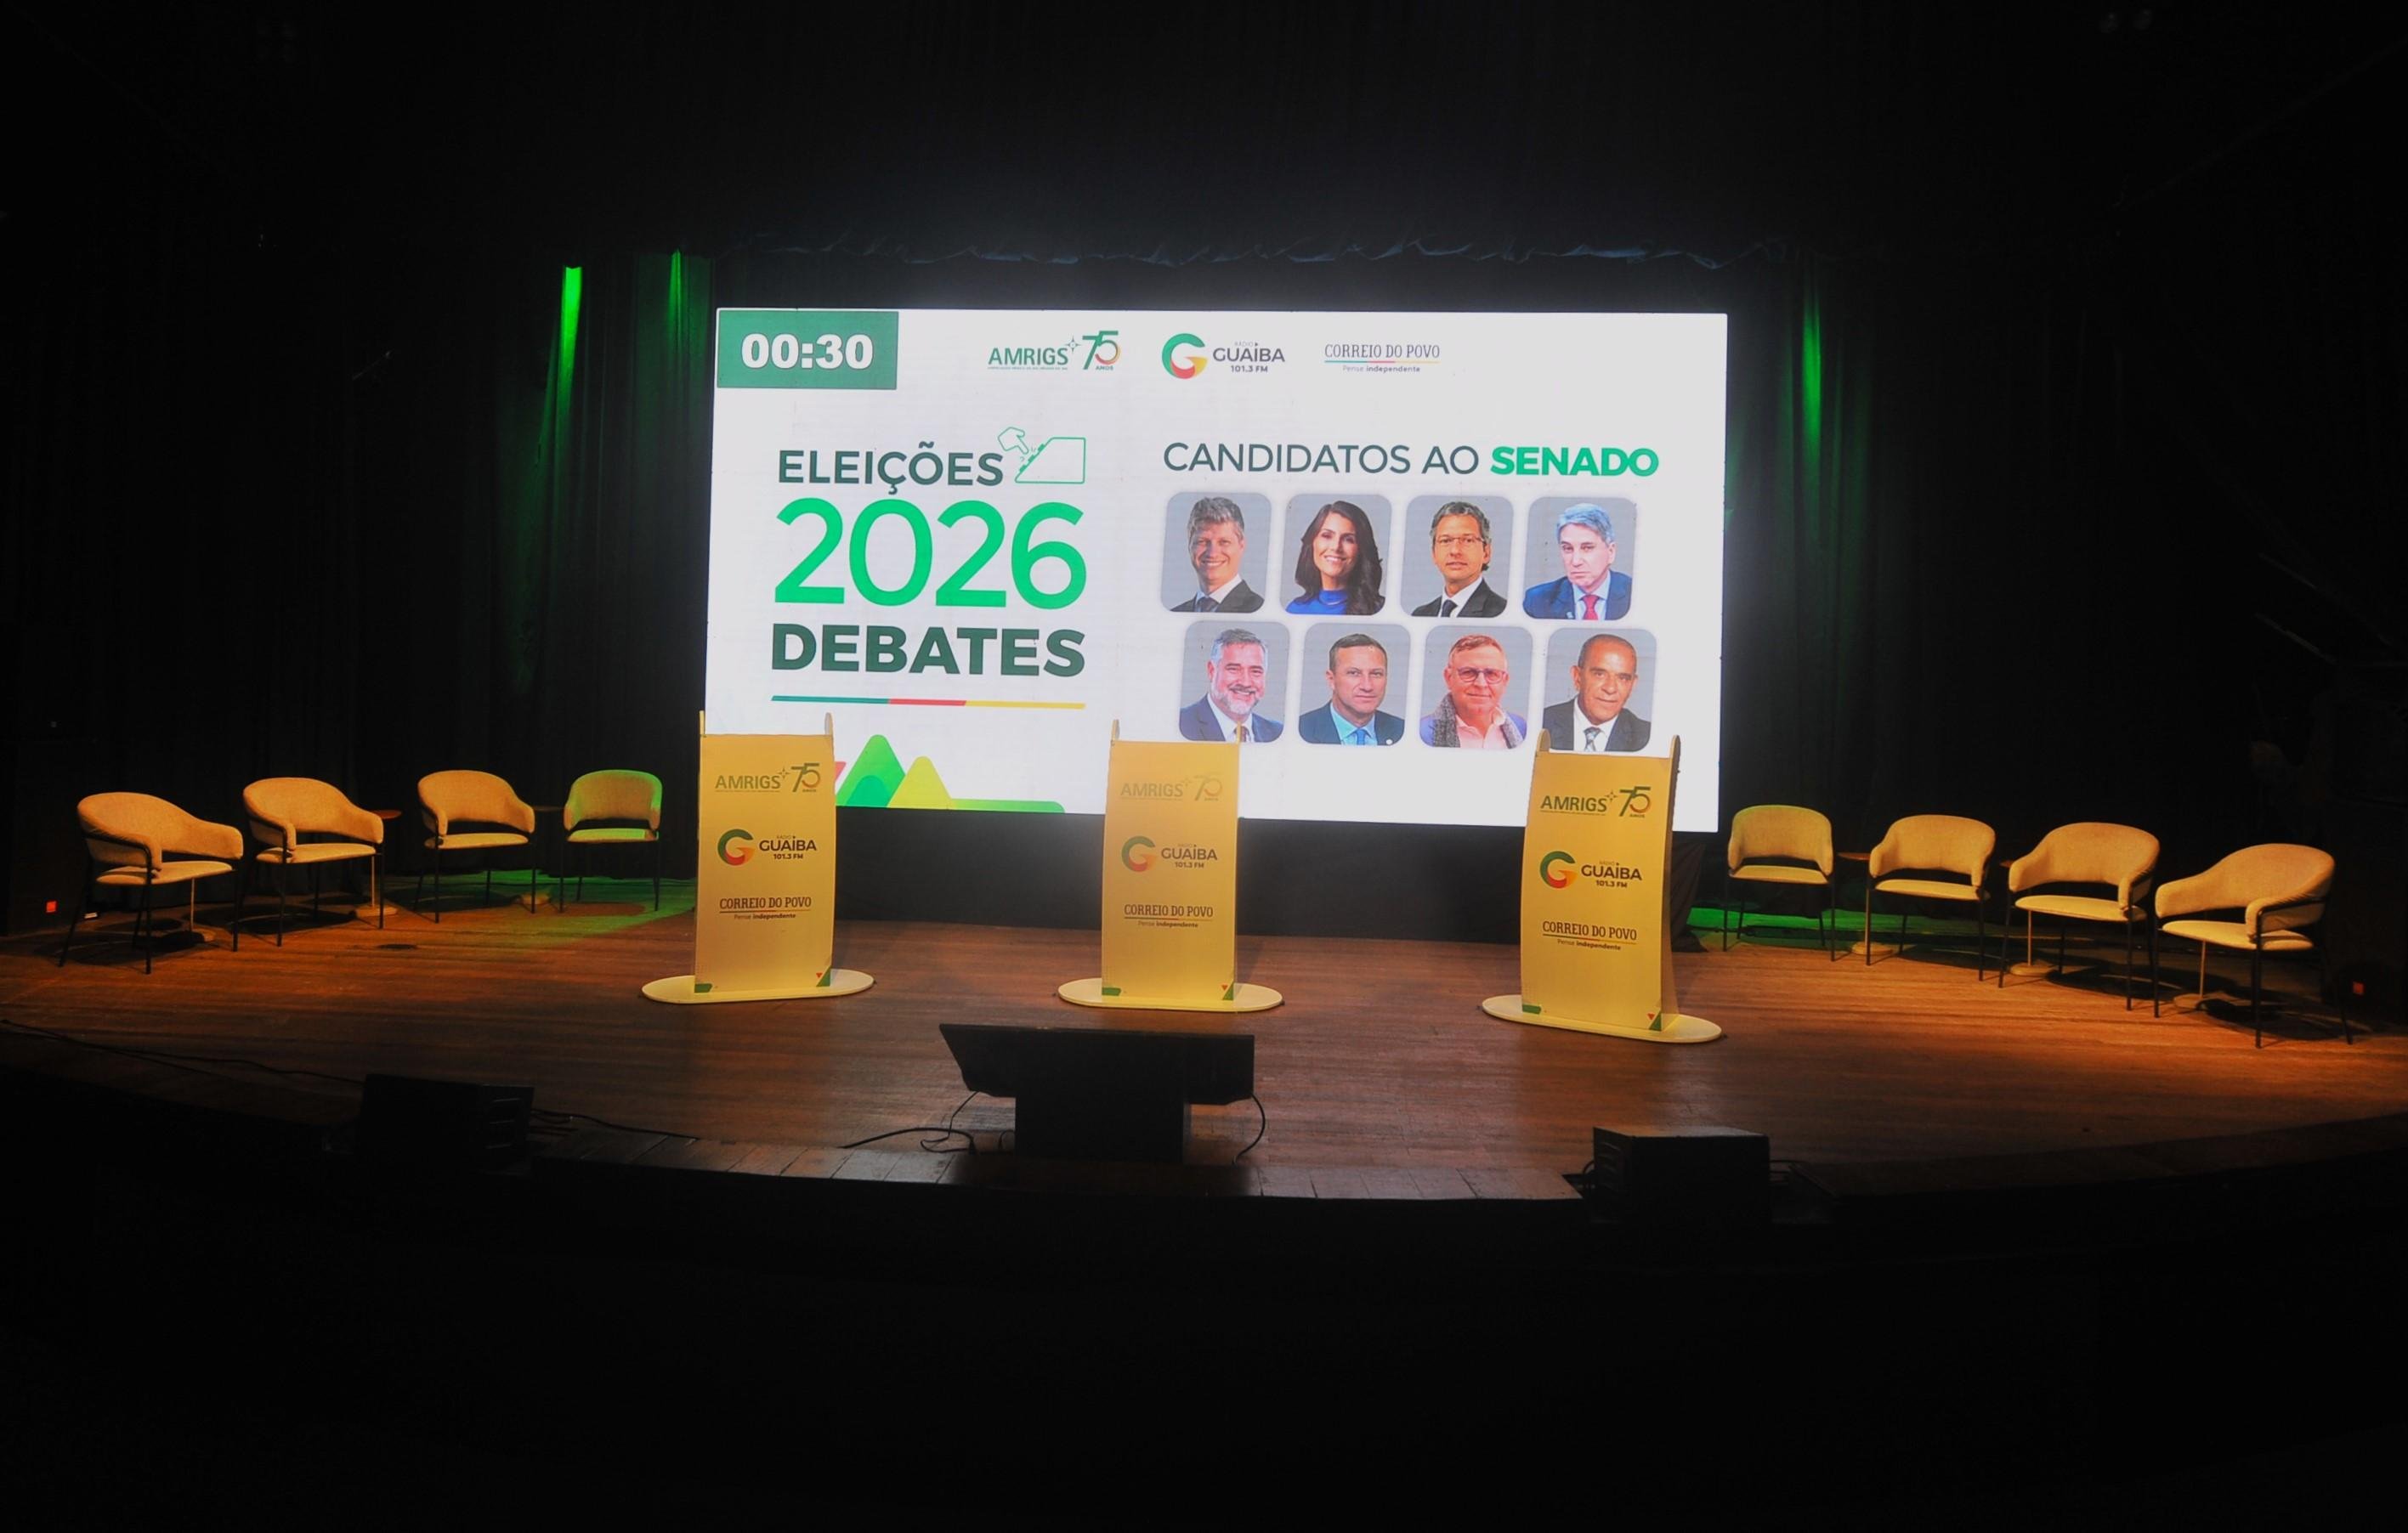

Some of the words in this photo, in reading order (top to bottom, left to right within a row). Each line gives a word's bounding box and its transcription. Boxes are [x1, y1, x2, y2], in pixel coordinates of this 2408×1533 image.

[741, 333, 874, 370] 00:30
[988, 348, 1068, 365] AMRIGS
[1082, 331, 1121, 370] 75
[1324, 344, 1382, 359] CORREIO
[1385, 344, 1402, 359] DO
[1406, 344, 1441, 359] POVO
[1366, 365, 1420, 373] independente
[779, 441, 1004, 495] ELEIÇÕES
[1163, 442, 1411, 474] CANDIDATOS
[1421, 445, 1479, 474] AO
[1490, 446, 1658, 477] SENADO
[774, 497, 1087, 609] 2026
[771, 623, 1085, 677] DEBATES
[715, 775, 781, 789] AMRIGS
[790, 762, 821, 792] 75
[1120, 783, 1183, 797] AMRIGS
[1540, 795, 1607, 812] AMRIGS
[1618, 786, 1651, 817] 75
[720, 897, 765, 909] CORREIO
[768, 897, 782, 908] DO
[785, 897, 812, 908] POVO
[1124, 904, 1169, 916] CORREIO
[1171, 905, 1184, 916] DO
[1187, 906, 1213, 918] POVO
[1543, 920, 1589, 936] CORREIO
[1592, 925, 1606, 937] DO
[1609, 927, 1637, 941] POVO
